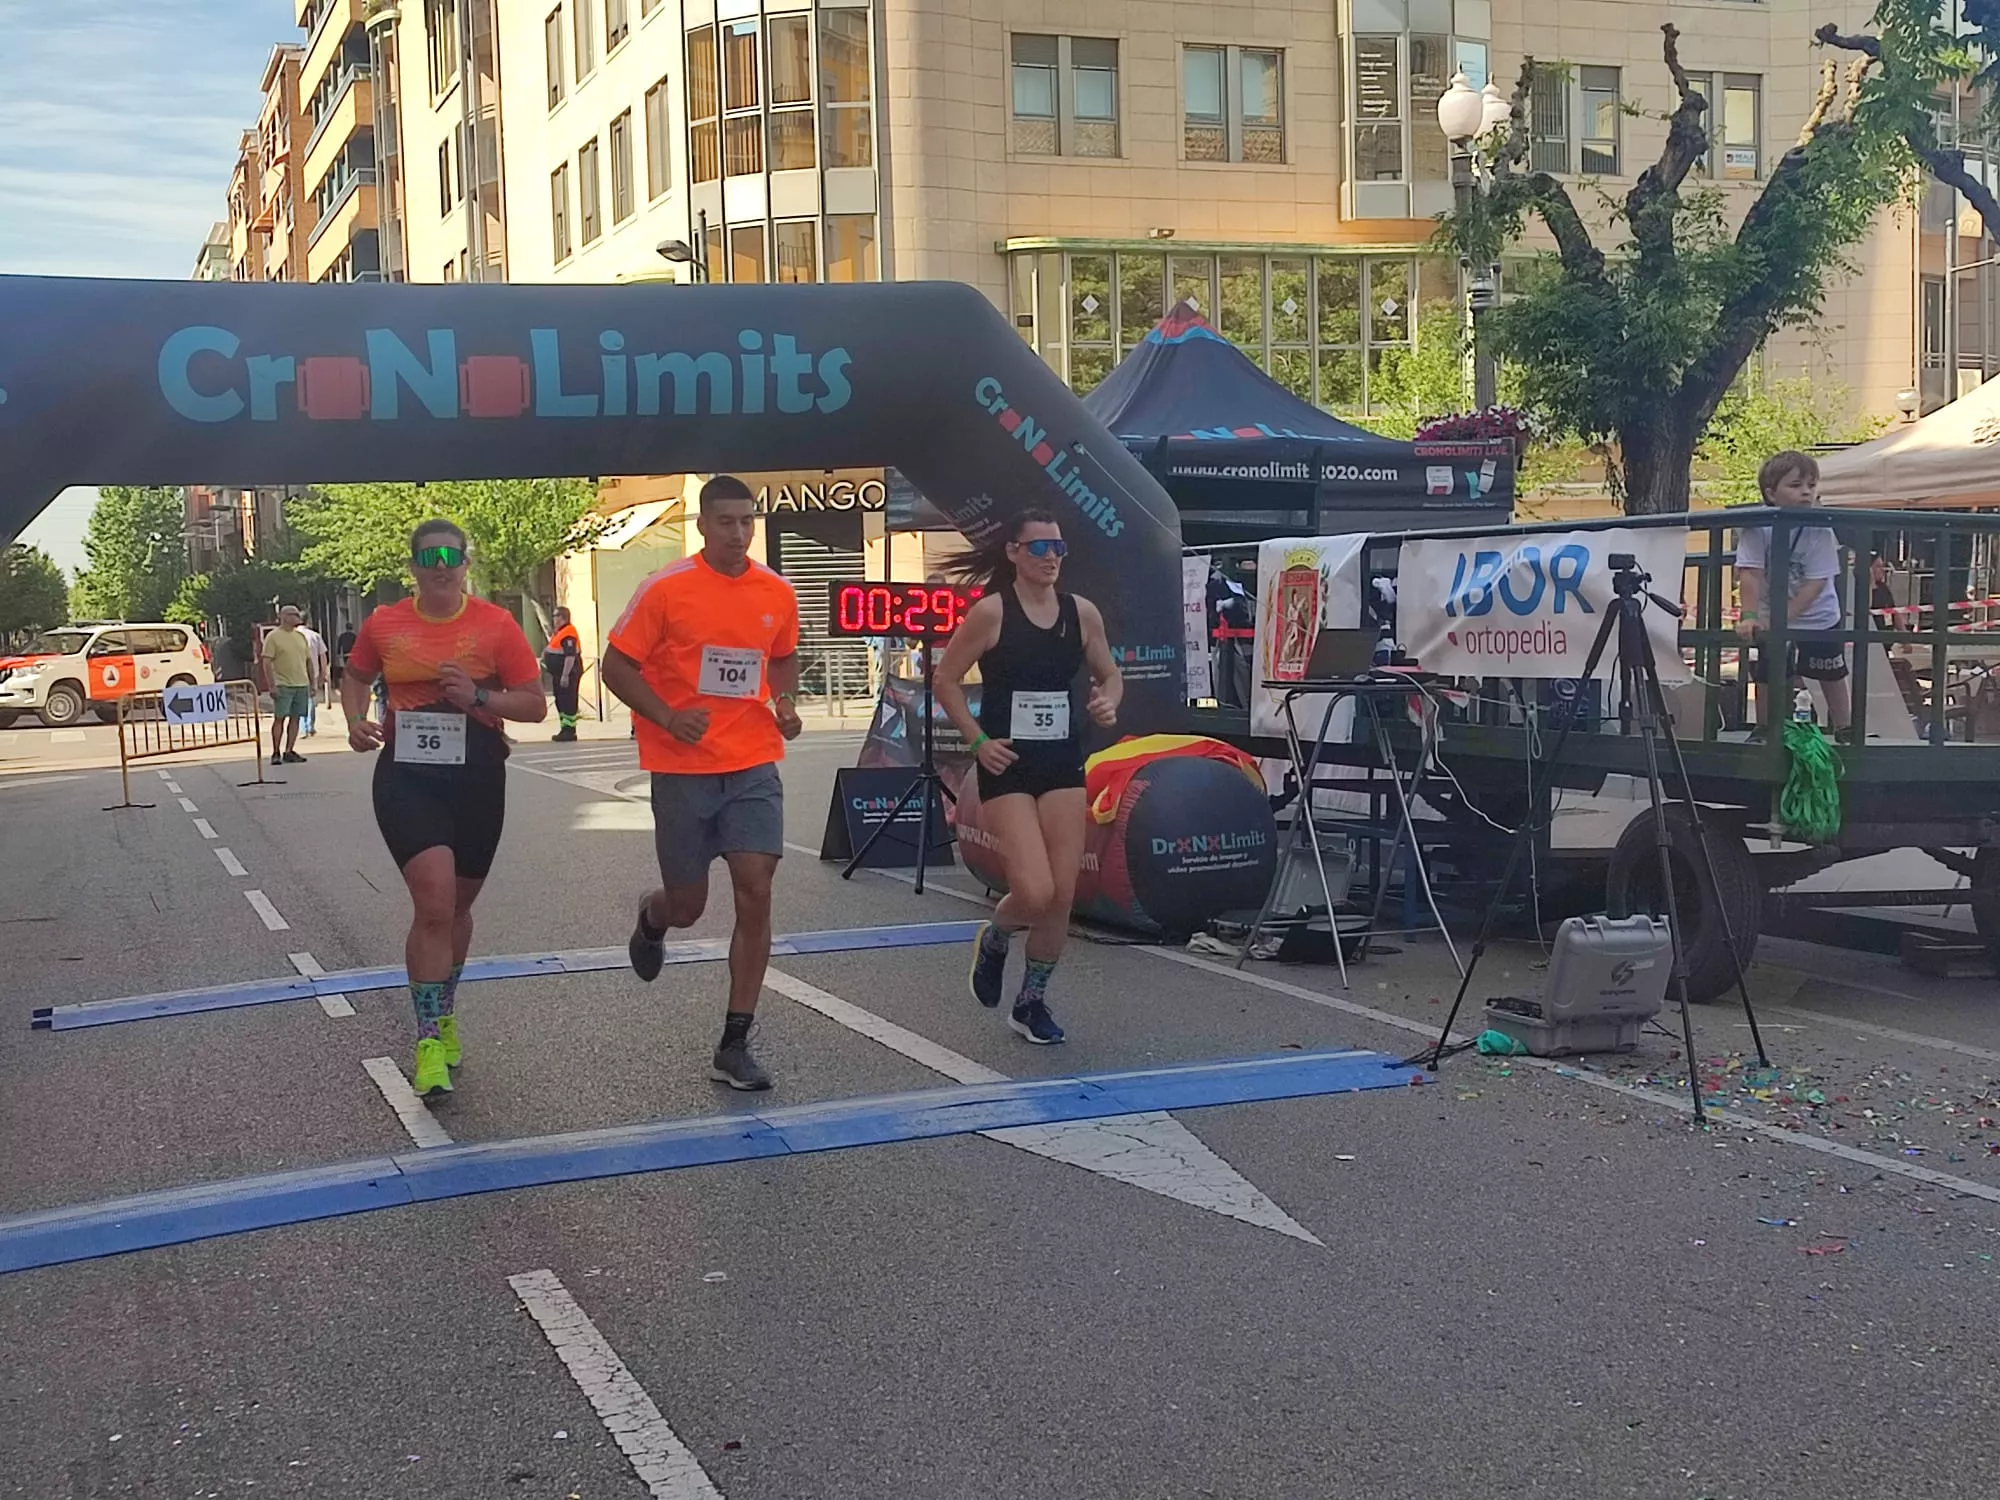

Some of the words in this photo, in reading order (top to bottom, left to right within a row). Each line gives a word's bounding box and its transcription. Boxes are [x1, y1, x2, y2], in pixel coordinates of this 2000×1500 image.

[1445, 544, 1595, 617] IBOR
[1465, 620, 1567, 664] ortopedia
[718, 667, 747, 683] 104
[195, 689, 226, 713] 10K
[1034, 713, 1054, 727] 35
[417, 734, 441, 750] 36
